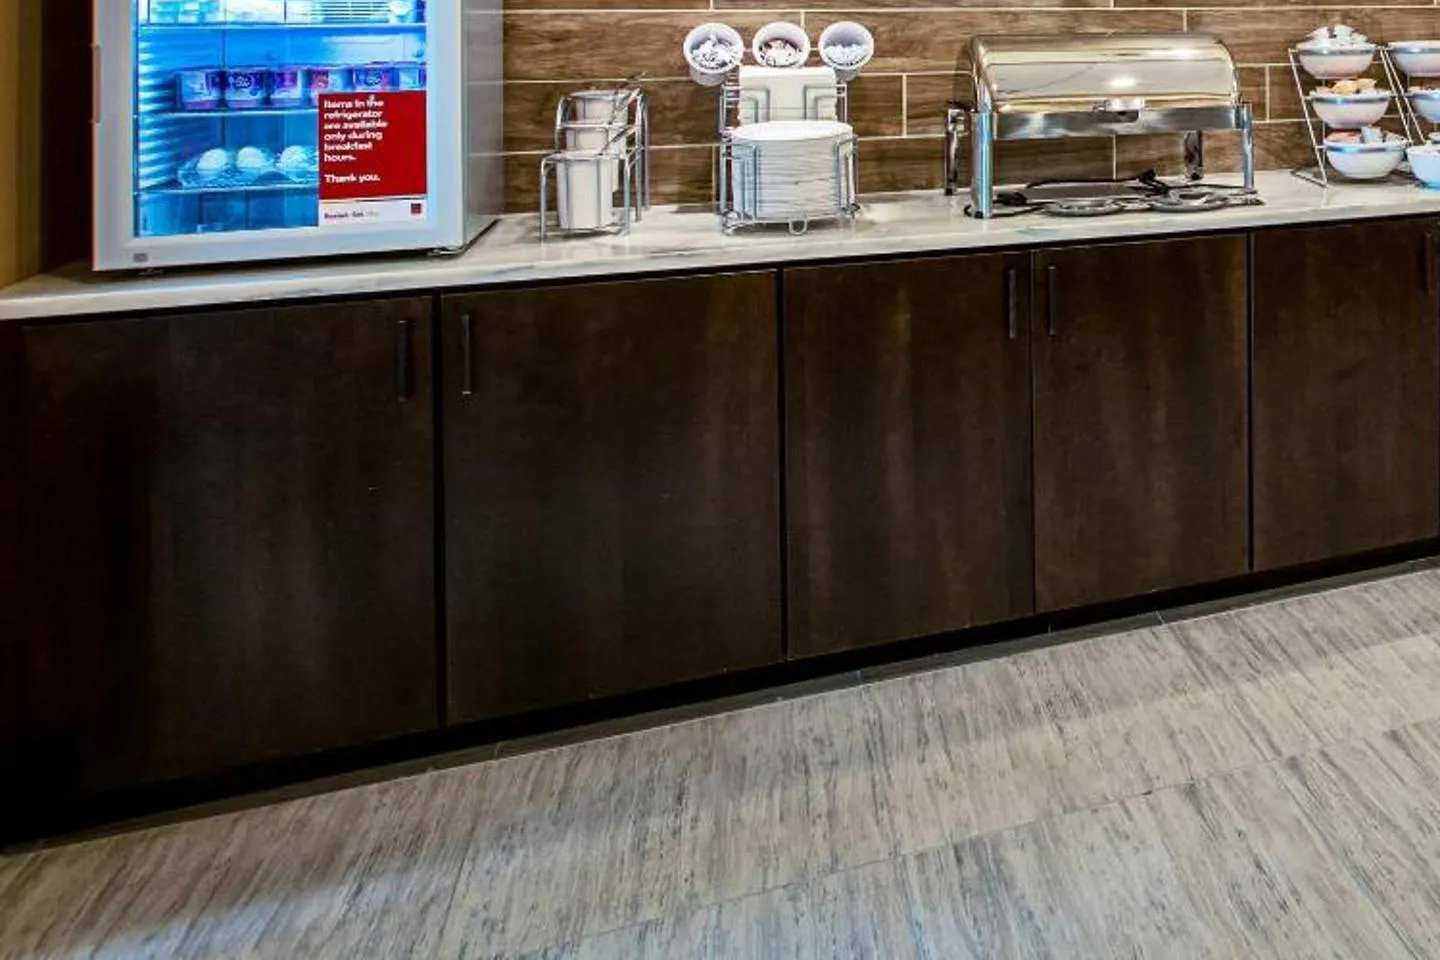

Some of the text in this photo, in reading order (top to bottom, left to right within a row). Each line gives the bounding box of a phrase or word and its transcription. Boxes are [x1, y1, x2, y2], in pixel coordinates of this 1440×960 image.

[324, 95, 384, 109] Items in the
[324, 110, 384, 120] refrigerator
[342, 120, 388, 129] available
[324, 130, 383, 141] only during
[324, 141, 373, 151] breakfast
[324, 173, 381, 183] Thank you.
